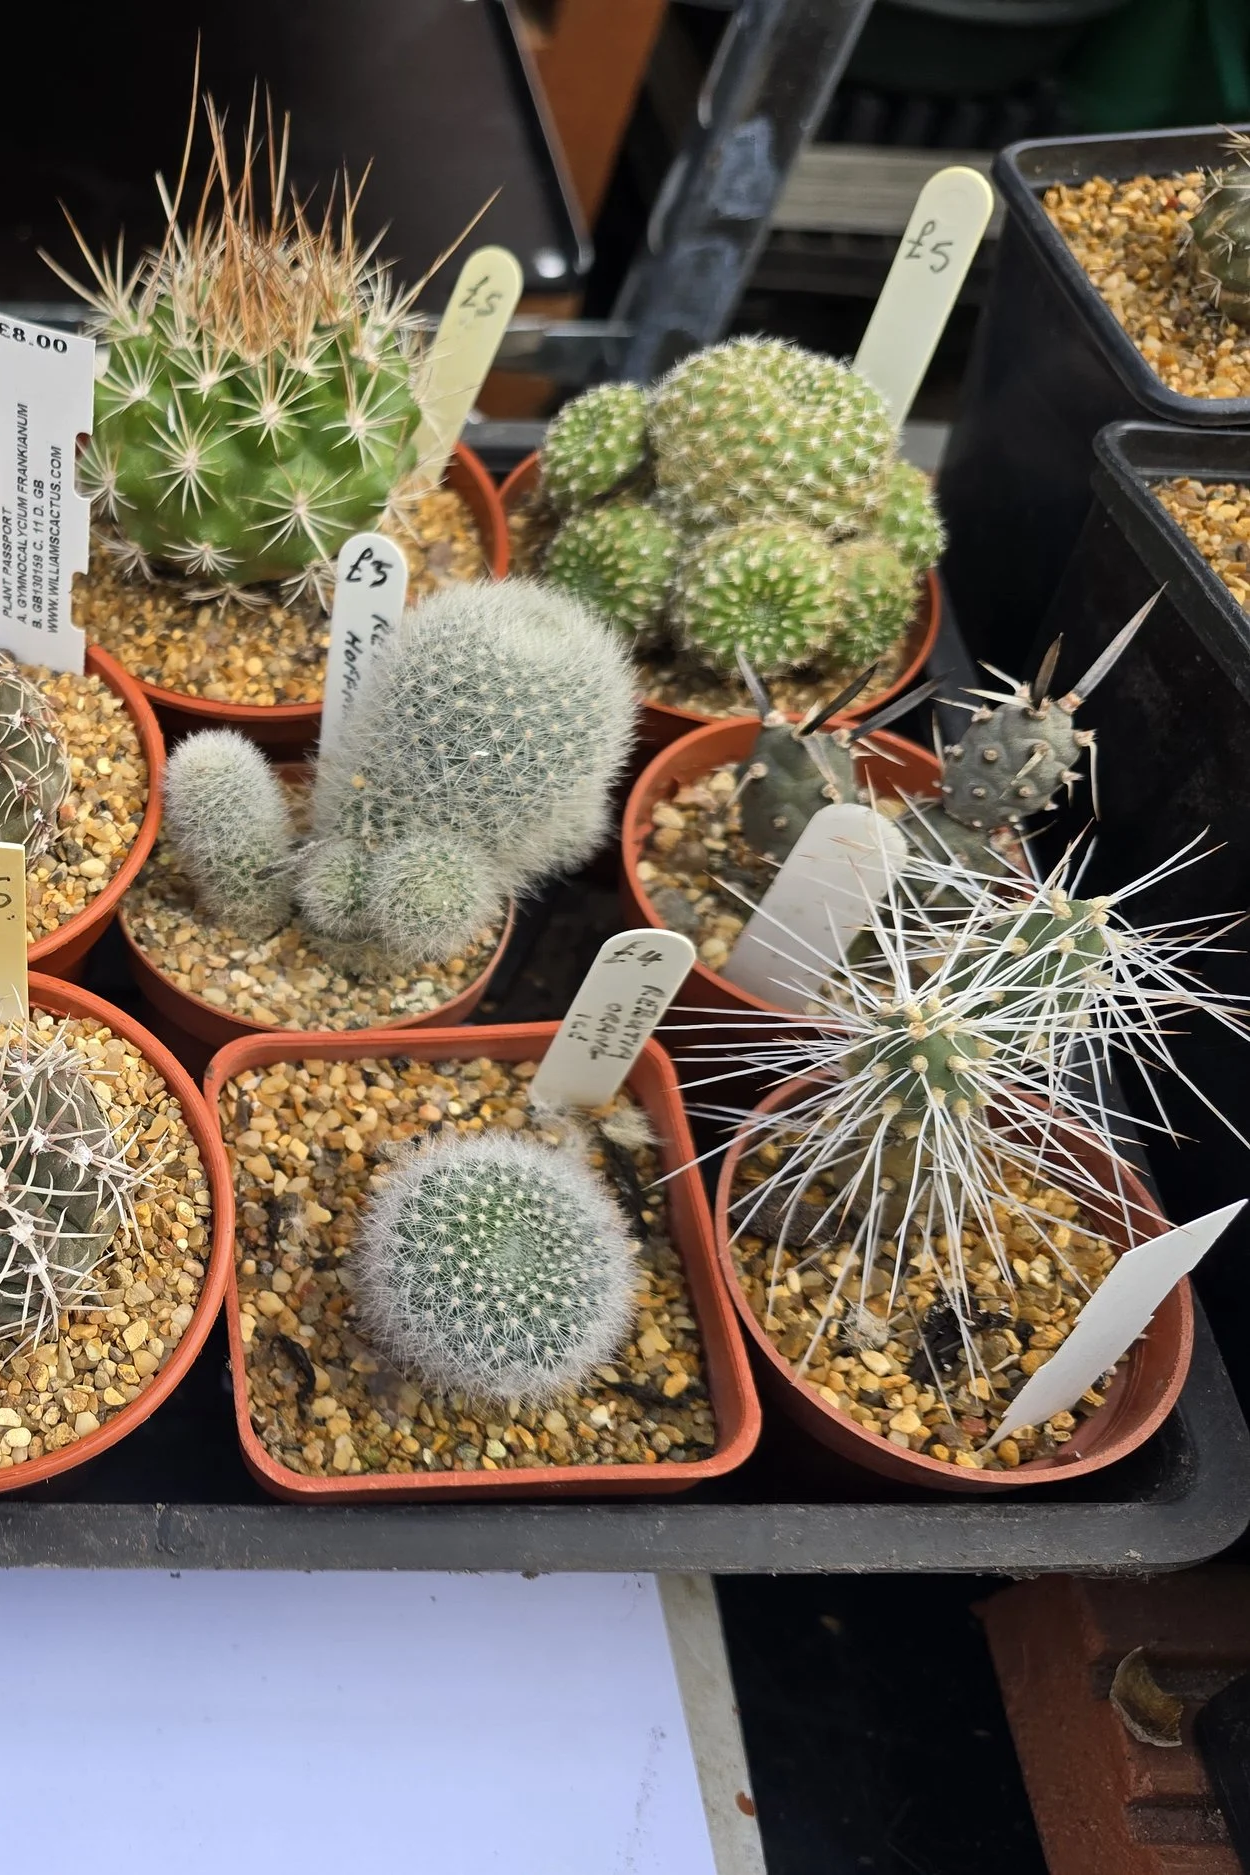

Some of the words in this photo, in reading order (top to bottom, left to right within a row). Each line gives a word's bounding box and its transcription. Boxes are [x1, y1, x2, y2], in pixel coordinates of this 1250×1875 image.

[905, 220, 954, 274] £5
[459, 275, 503, 316] £5
[17, 403, 29, 494] FRANKIANUM
[32, 479, 45, 500] GB
[32, 505, 44, 517] D.
[32, 521, 44, 534] 11
[1, 507, 13, 575] PASSPORT
[16, 498, 28, 608] GYMNOCALYCIUM
[32, 540, 44, 551] C.
[47, 446, 62, 633] WWW.WILLIAMSCACTUS.COM
[2, 579, 14, 618] PLANT
[32, 554, 45, 613] GB130159
[16, 613, 28, 624] A.
[32, 618, 43, 630] B.
[602, 941, 664, 967] £4
